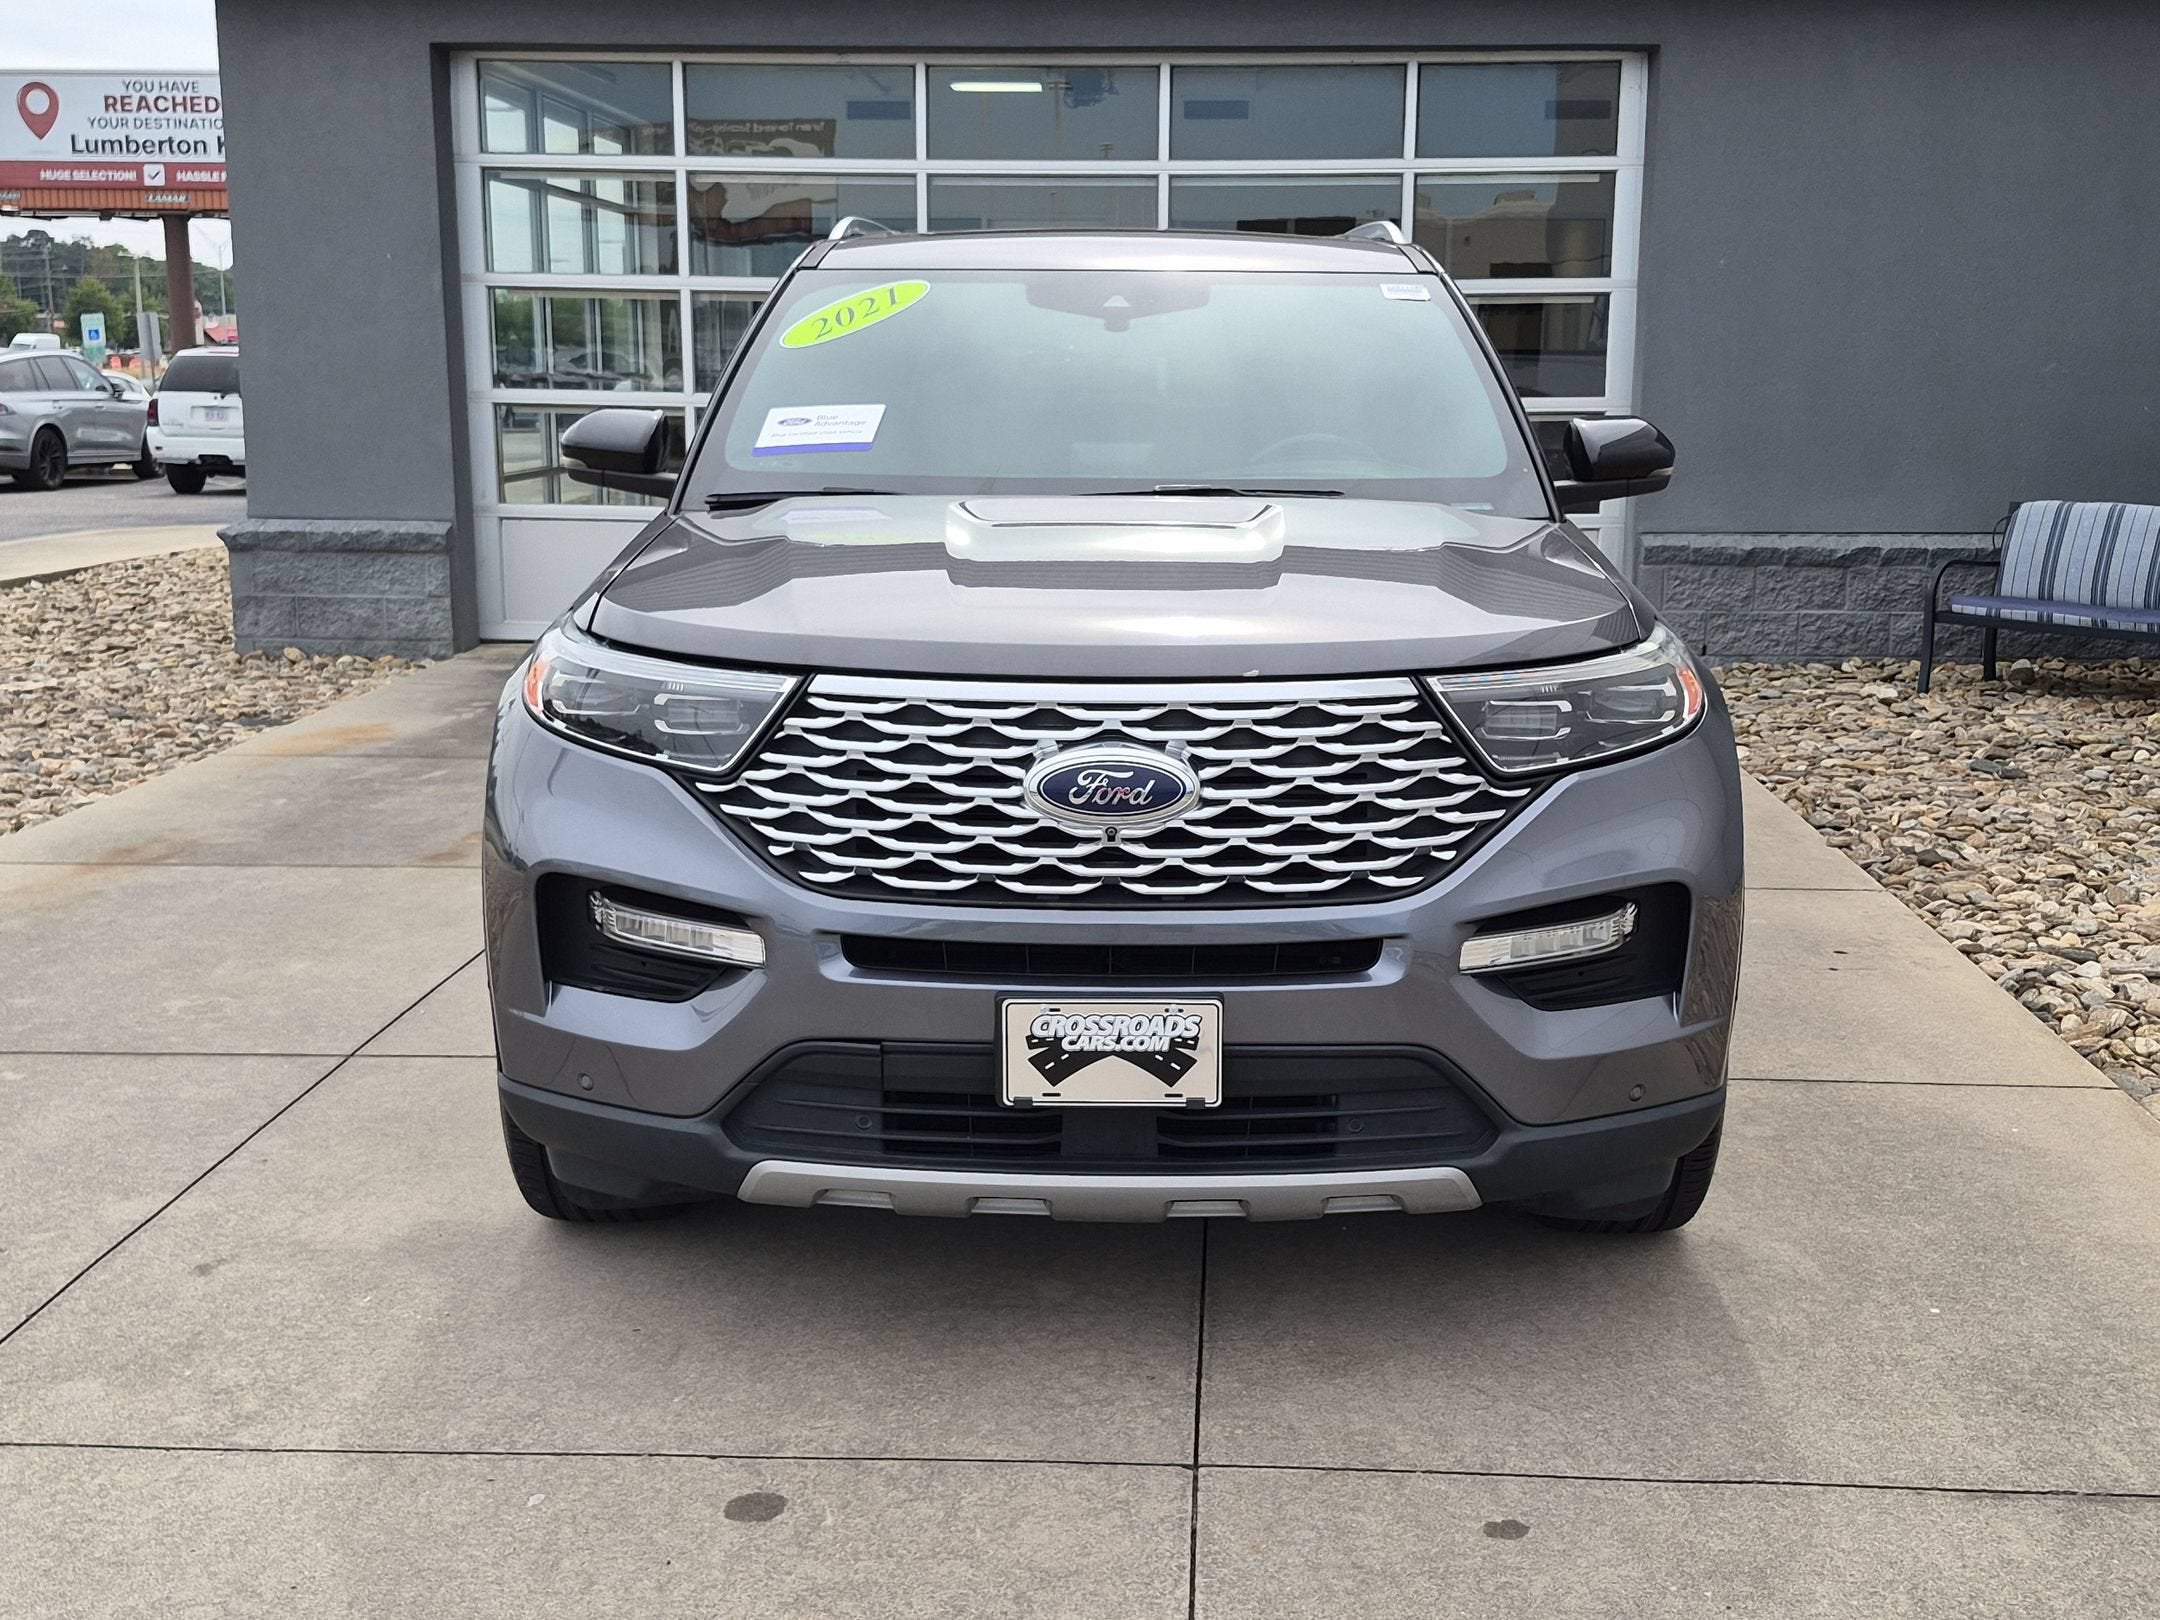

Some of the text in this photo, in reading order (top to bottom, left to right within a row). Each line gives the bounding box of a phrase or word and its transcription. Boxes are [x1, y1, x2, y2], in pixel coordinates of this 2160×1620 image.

[121, 80, 200, 93] YOU HAVE
[103, 94, 220, 113] REACHED
[87, 116, 129, 130] YOUR
[70, 134, 208, 155] Lumberton
[40, 168, 71, 181] HUGE
[811, 287, 900, 340] 2021
[1068, 769, 1153, 806] Ford
[1030, 1014, 1203, 1038] CROSSROADS
[1061, 1035, 1172, 1052] CARS.COM
